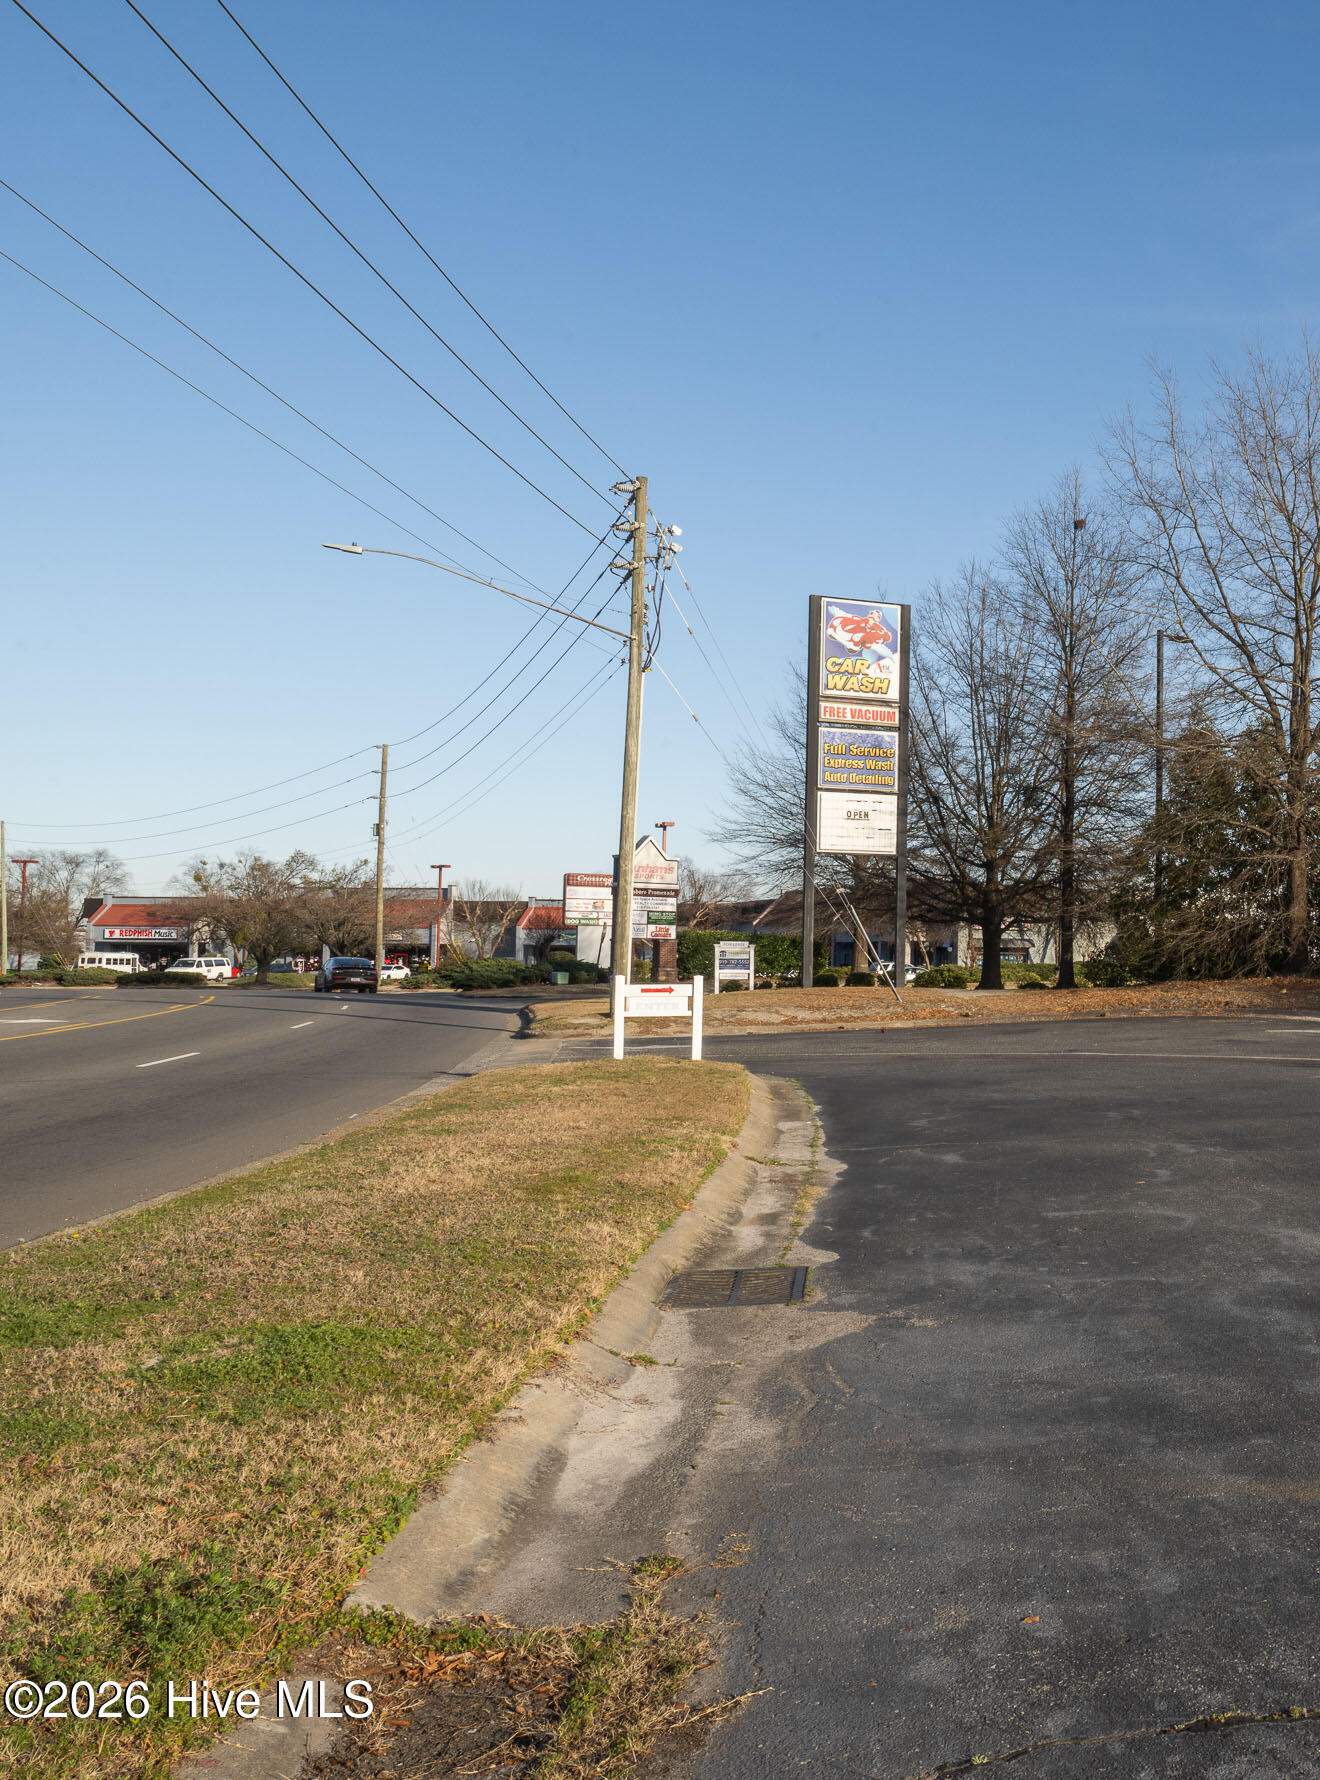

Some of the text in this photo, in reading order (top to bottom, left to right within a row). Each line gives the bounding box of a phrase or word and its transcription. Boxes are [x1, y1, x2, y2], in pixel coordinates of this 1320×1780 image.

[825, 657, 870, 676] CAR
[826, 673, 890, 695] WASH
[823, 706, 896, 723] FREE VACUUM
[823, 743, 894, 758] Full Service
[823, 756, 894, 771] Express Wash
[823, 771, 894, 787] Auto Detailing
[846, 810, 869, 819] OPEN
[119, 929, 174, 938] REDPHISH Music
